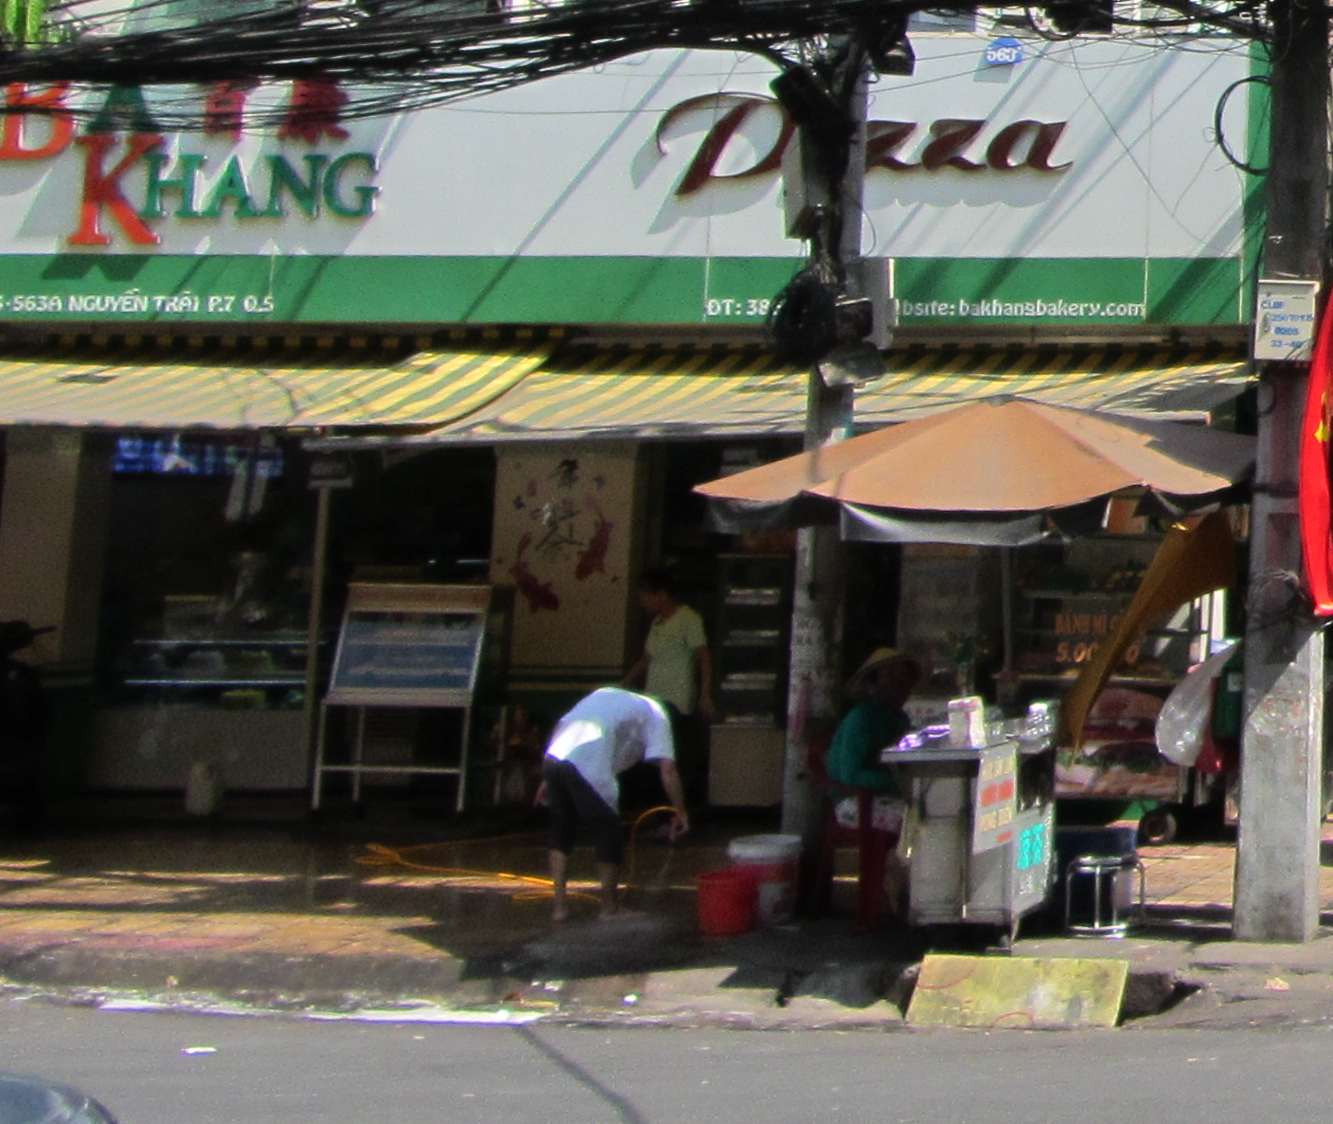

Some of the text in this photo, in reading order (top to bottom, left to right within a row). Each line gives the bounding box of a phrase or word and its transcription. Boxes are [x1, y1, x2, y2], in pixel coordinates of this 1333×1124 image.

[67, 134, 380, 245] KHANG
[656, 91, 1075, 197] Pzza
[207, 295, 236, 313] P.7
